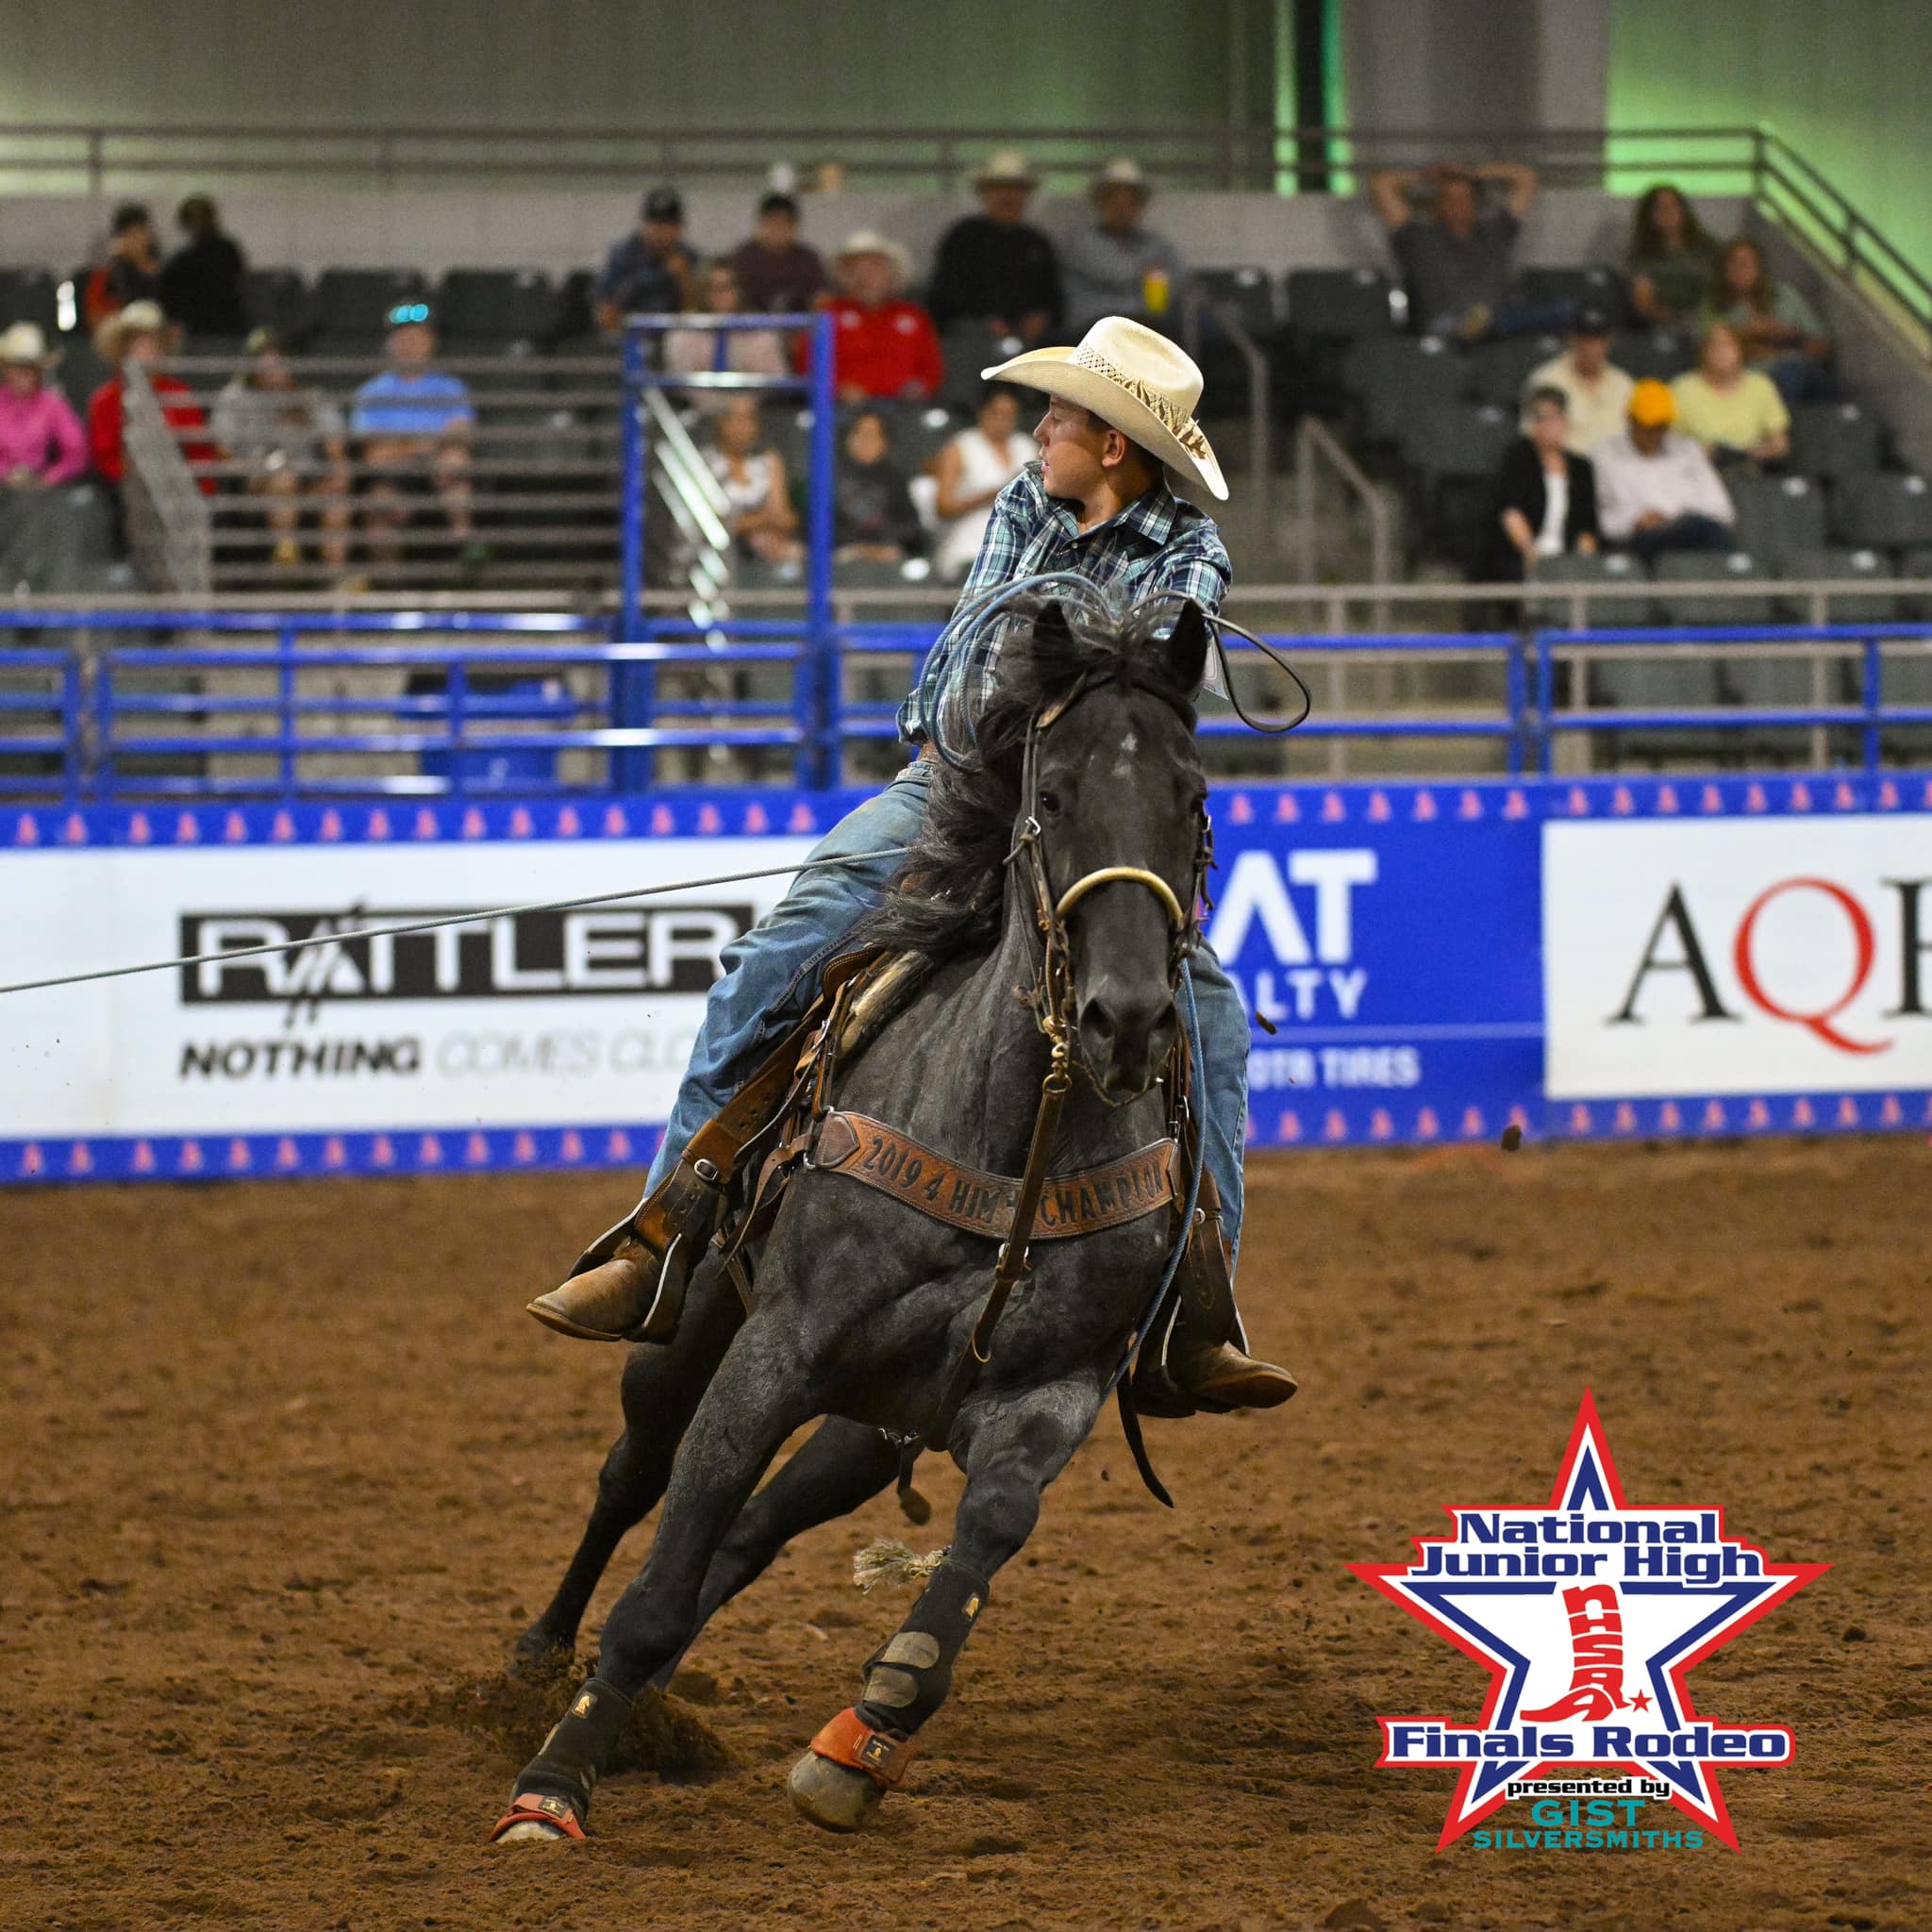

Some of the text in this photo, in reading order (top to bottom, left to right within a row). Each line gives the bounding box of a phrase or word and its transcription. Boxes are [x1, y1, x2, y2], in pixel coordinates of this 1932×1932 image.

[197, 910, 740, 998] RATTLER
[180, 1036, 421, 1079] NOTHING
[436, 1027, 605, 1078] COMES
[1323, 1047, 1421, 1088] TIRES
[862, 1135, 923, 1191] 2019
[924, 1172, 946, 1201] 4
[1040, 1160, 1164, 1227] CHAMPION
